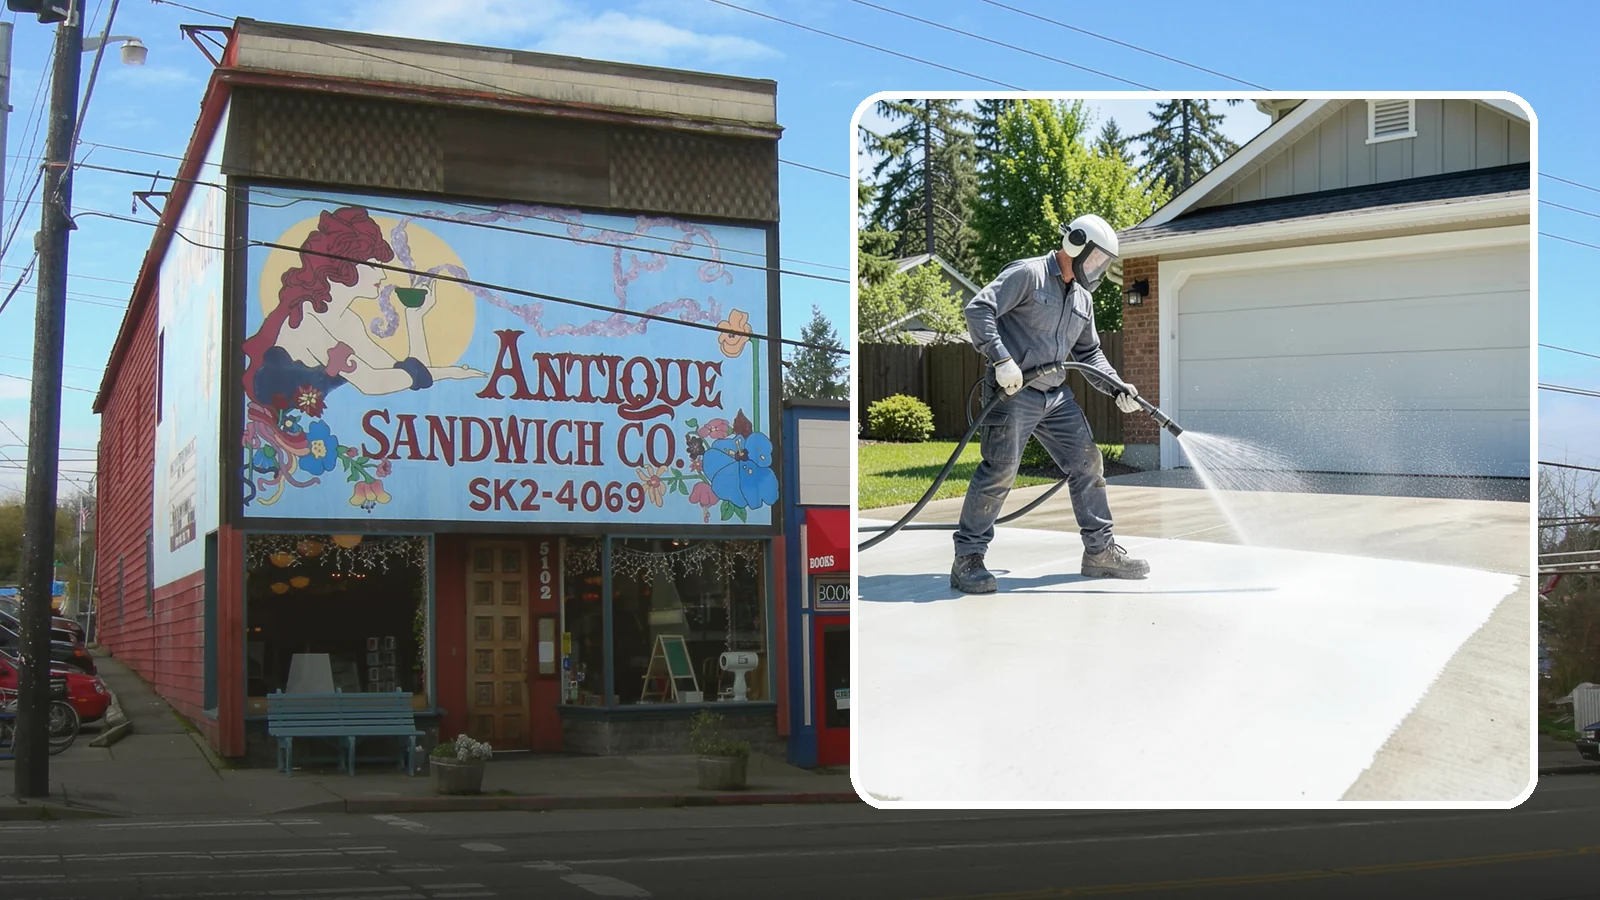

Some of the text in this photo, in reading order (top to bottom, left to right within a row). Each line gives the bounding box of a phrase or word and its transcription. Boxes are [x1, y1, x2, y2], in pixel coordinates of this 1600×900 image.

[475, 328, 724, 421] ANTIQUE
[361, 408, 685, 469] SANDWICH CO.
[468, 477, 646, 513] SK2-4069
[539, 541, 552, 600] 5102
[809, 555, 834, 569] BOOKS
